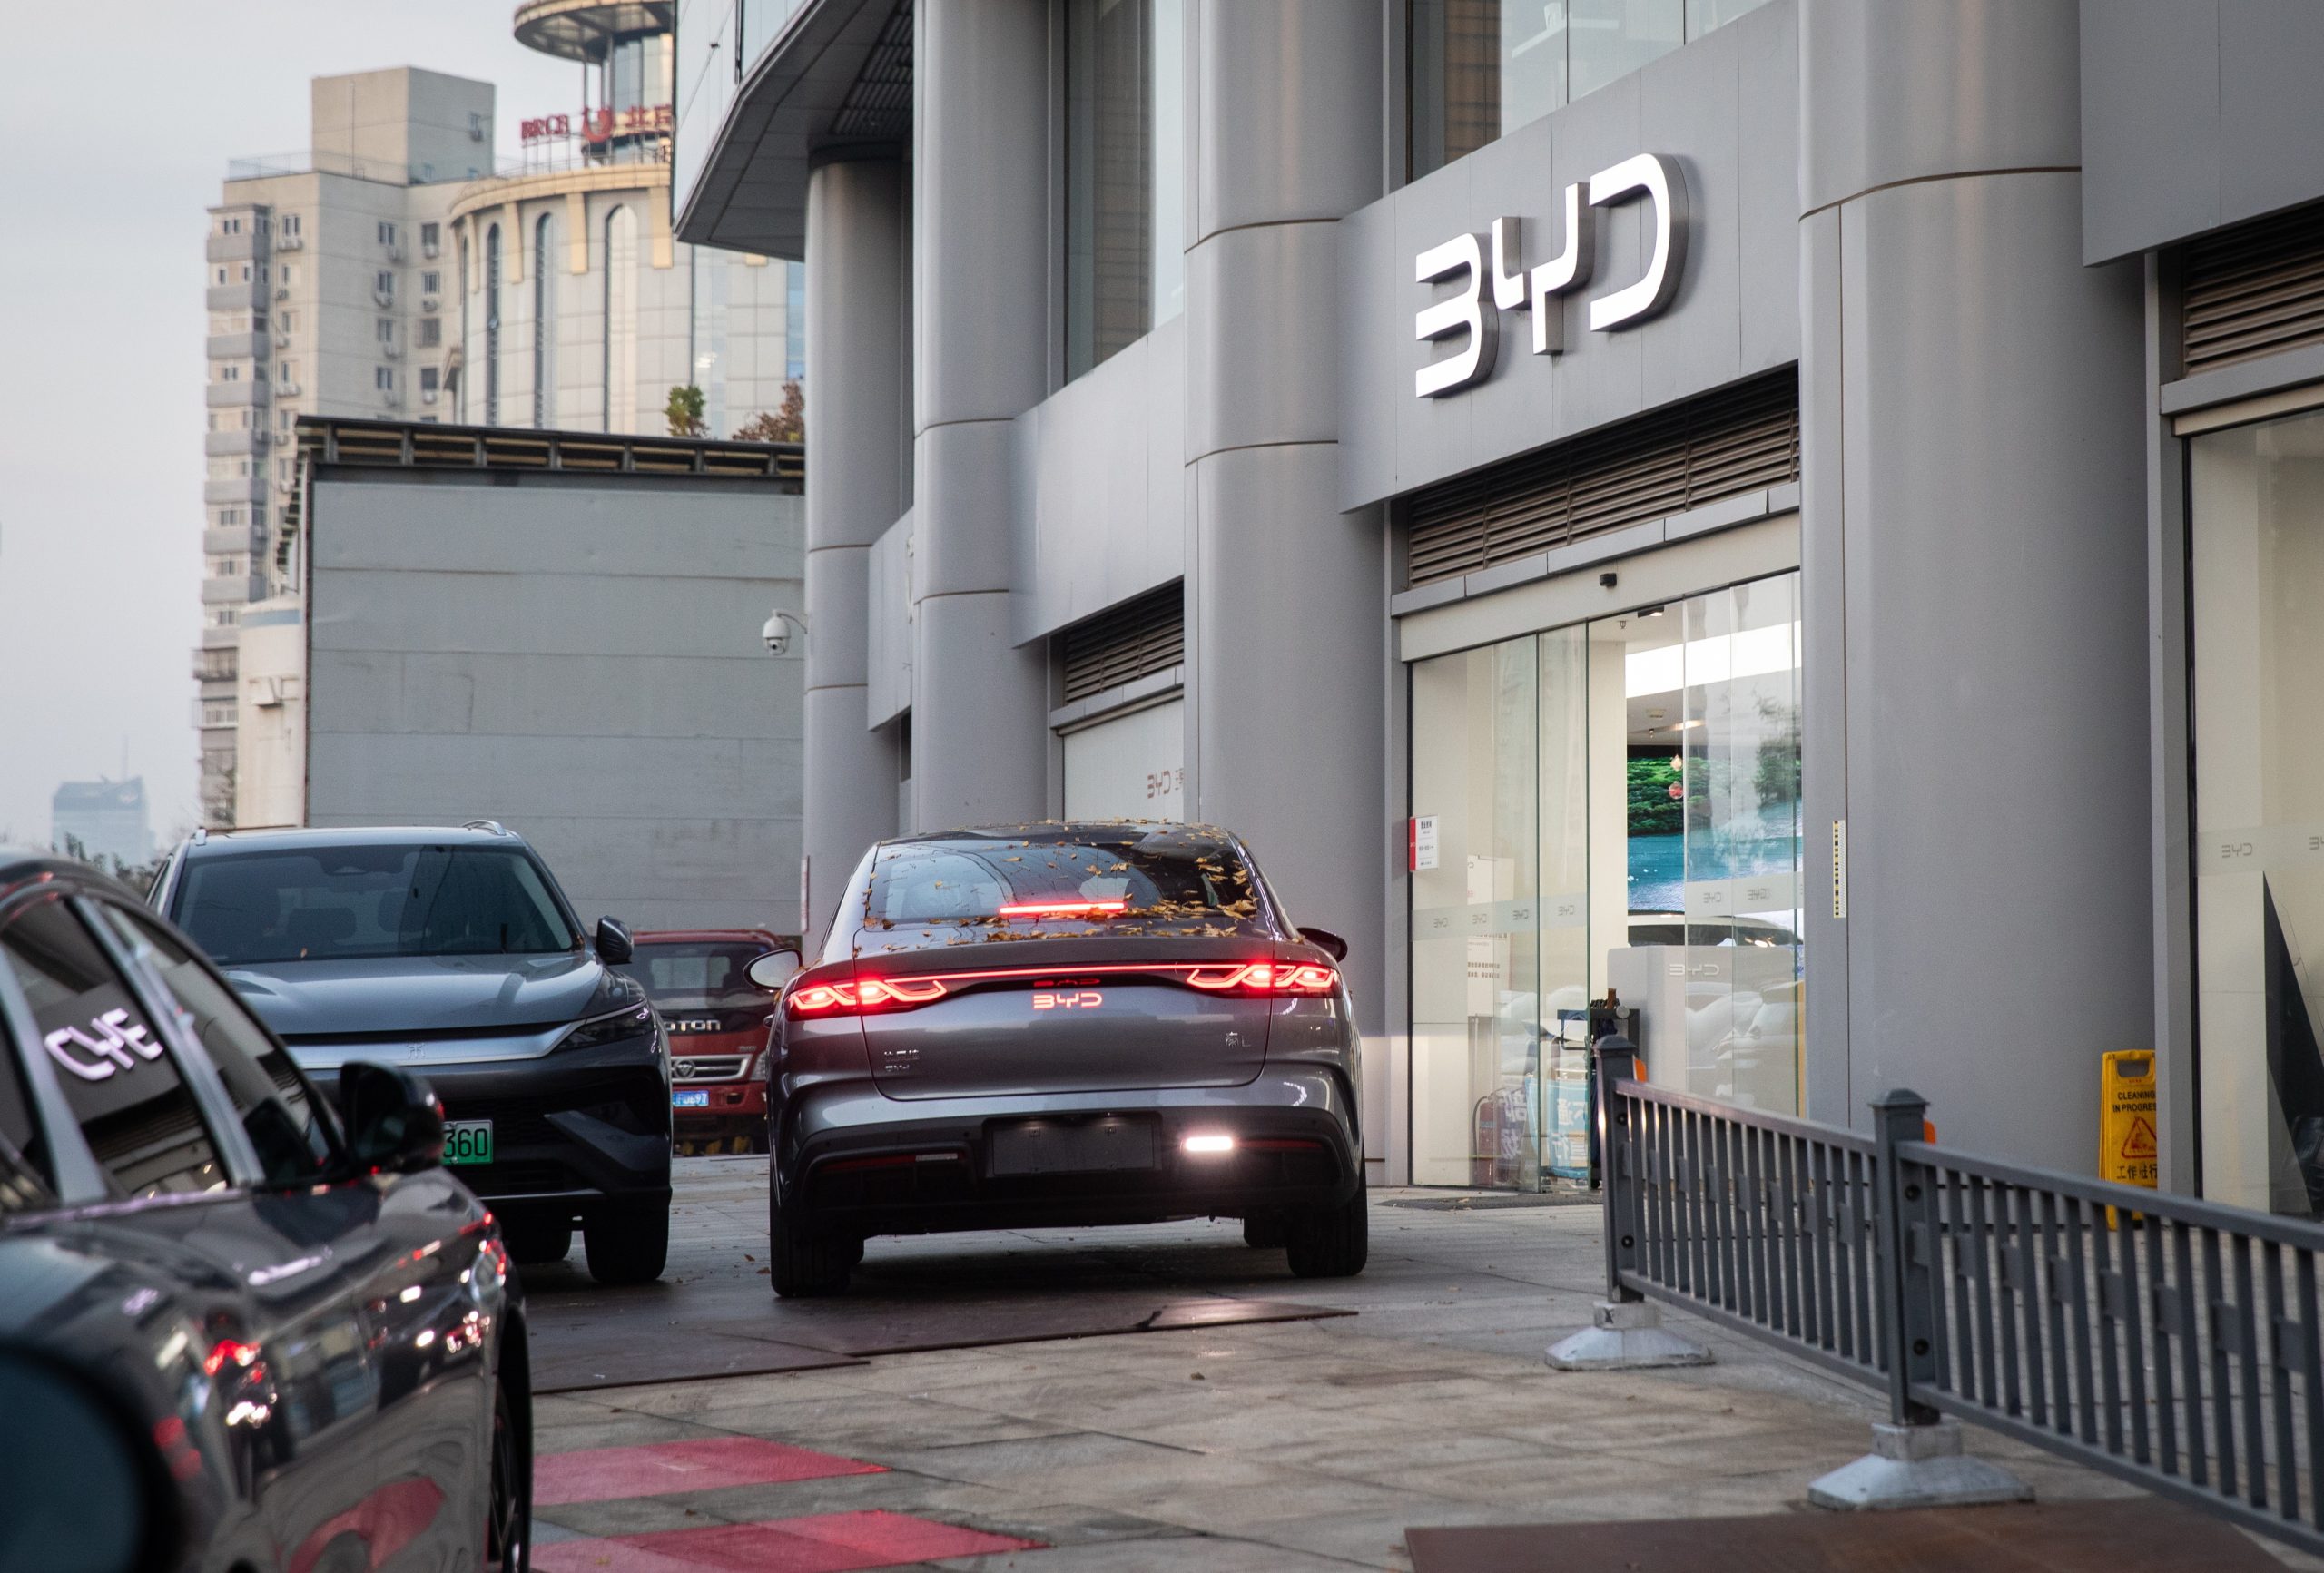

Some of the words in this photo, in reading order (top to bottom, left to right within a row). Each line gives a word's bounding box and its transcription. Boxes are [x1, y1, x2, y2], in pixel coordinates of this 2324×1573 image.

[1415, 152, 1689, 399] BYD
[1147, 770, 1171, 799] BYD
[2221, 842, 2253, 859] BYD
[1033, 992, 1103, 1009] BYD
[663, 1019, 721, 1032] OTON
[2117, 1090, 2156, 1100] CLEANING
[2112, 1104, 2121, 1113] IN
